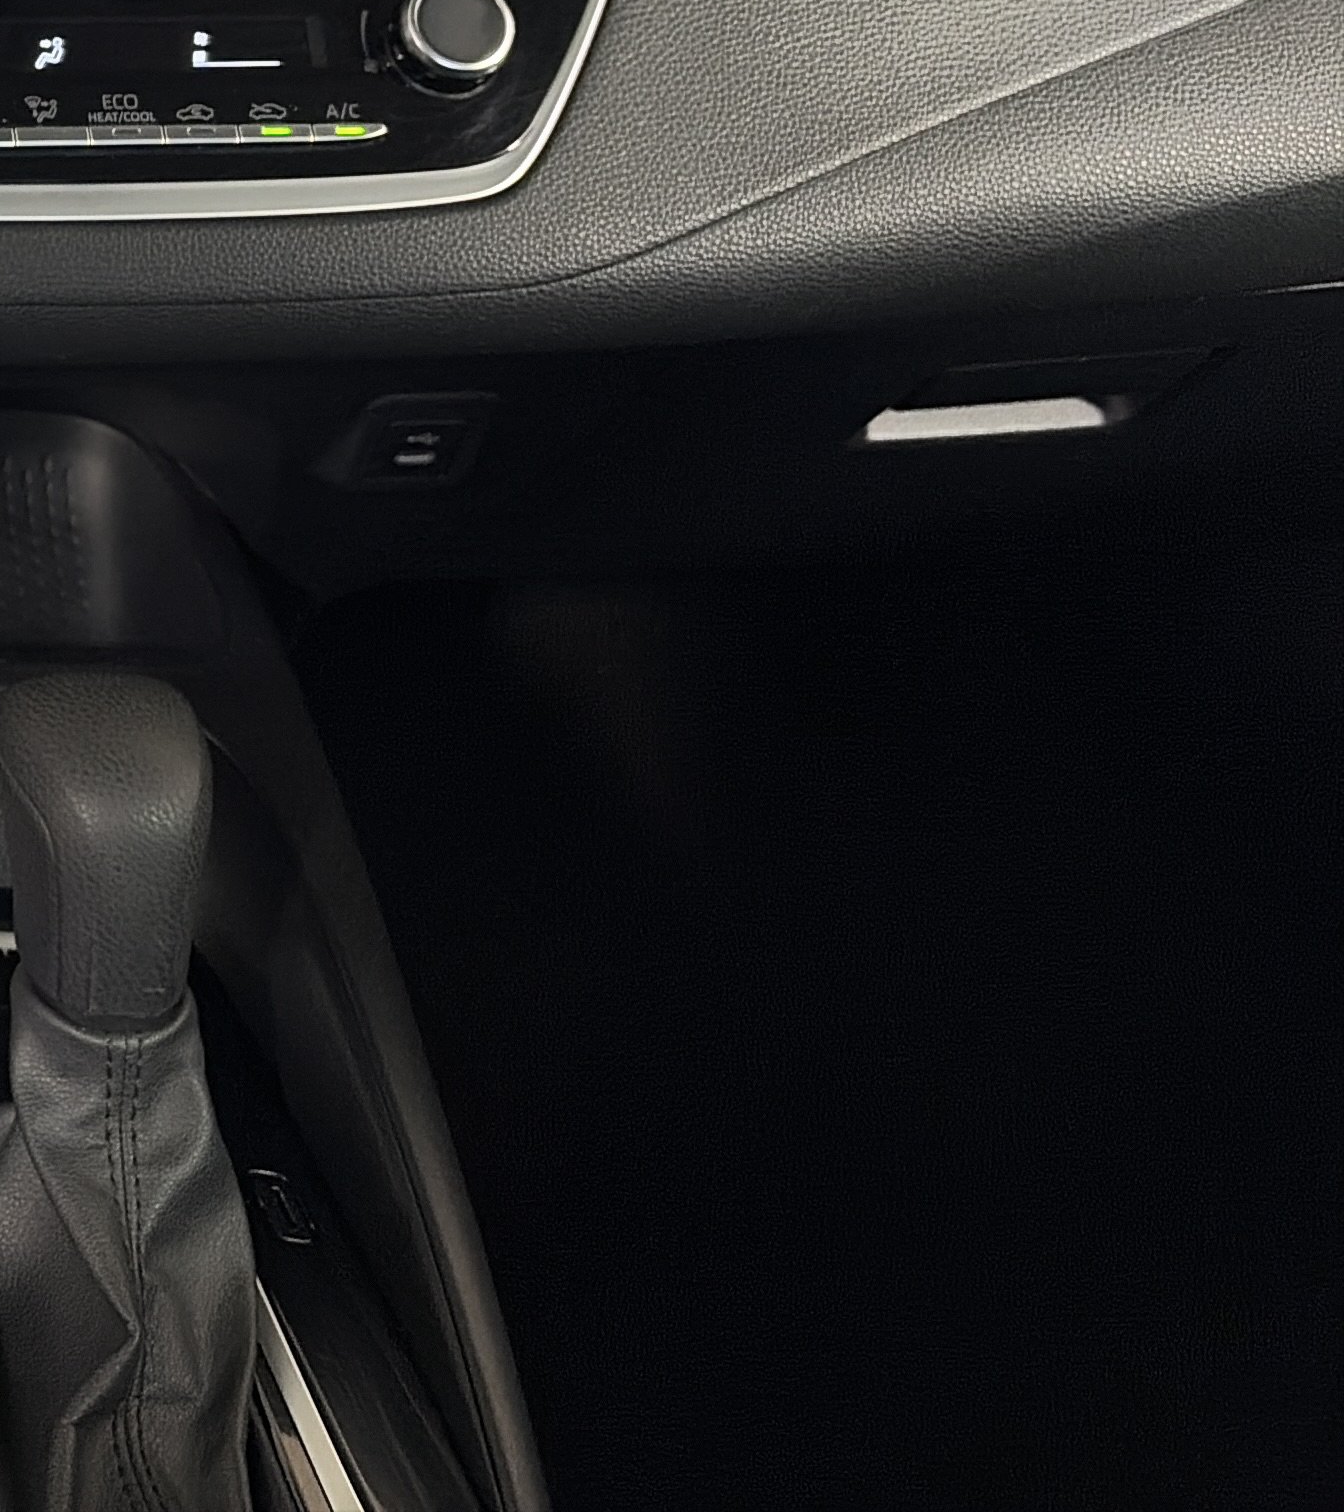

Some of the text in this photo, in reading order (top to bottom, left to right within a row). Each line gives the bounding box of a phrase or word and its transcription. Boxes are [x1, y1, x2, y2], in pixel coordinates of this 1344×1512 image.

[101, 93, 139, 110] ECO
[88, 110, 156, 123] HEAT/COOL
[325, 102, 361, 120] A/C
